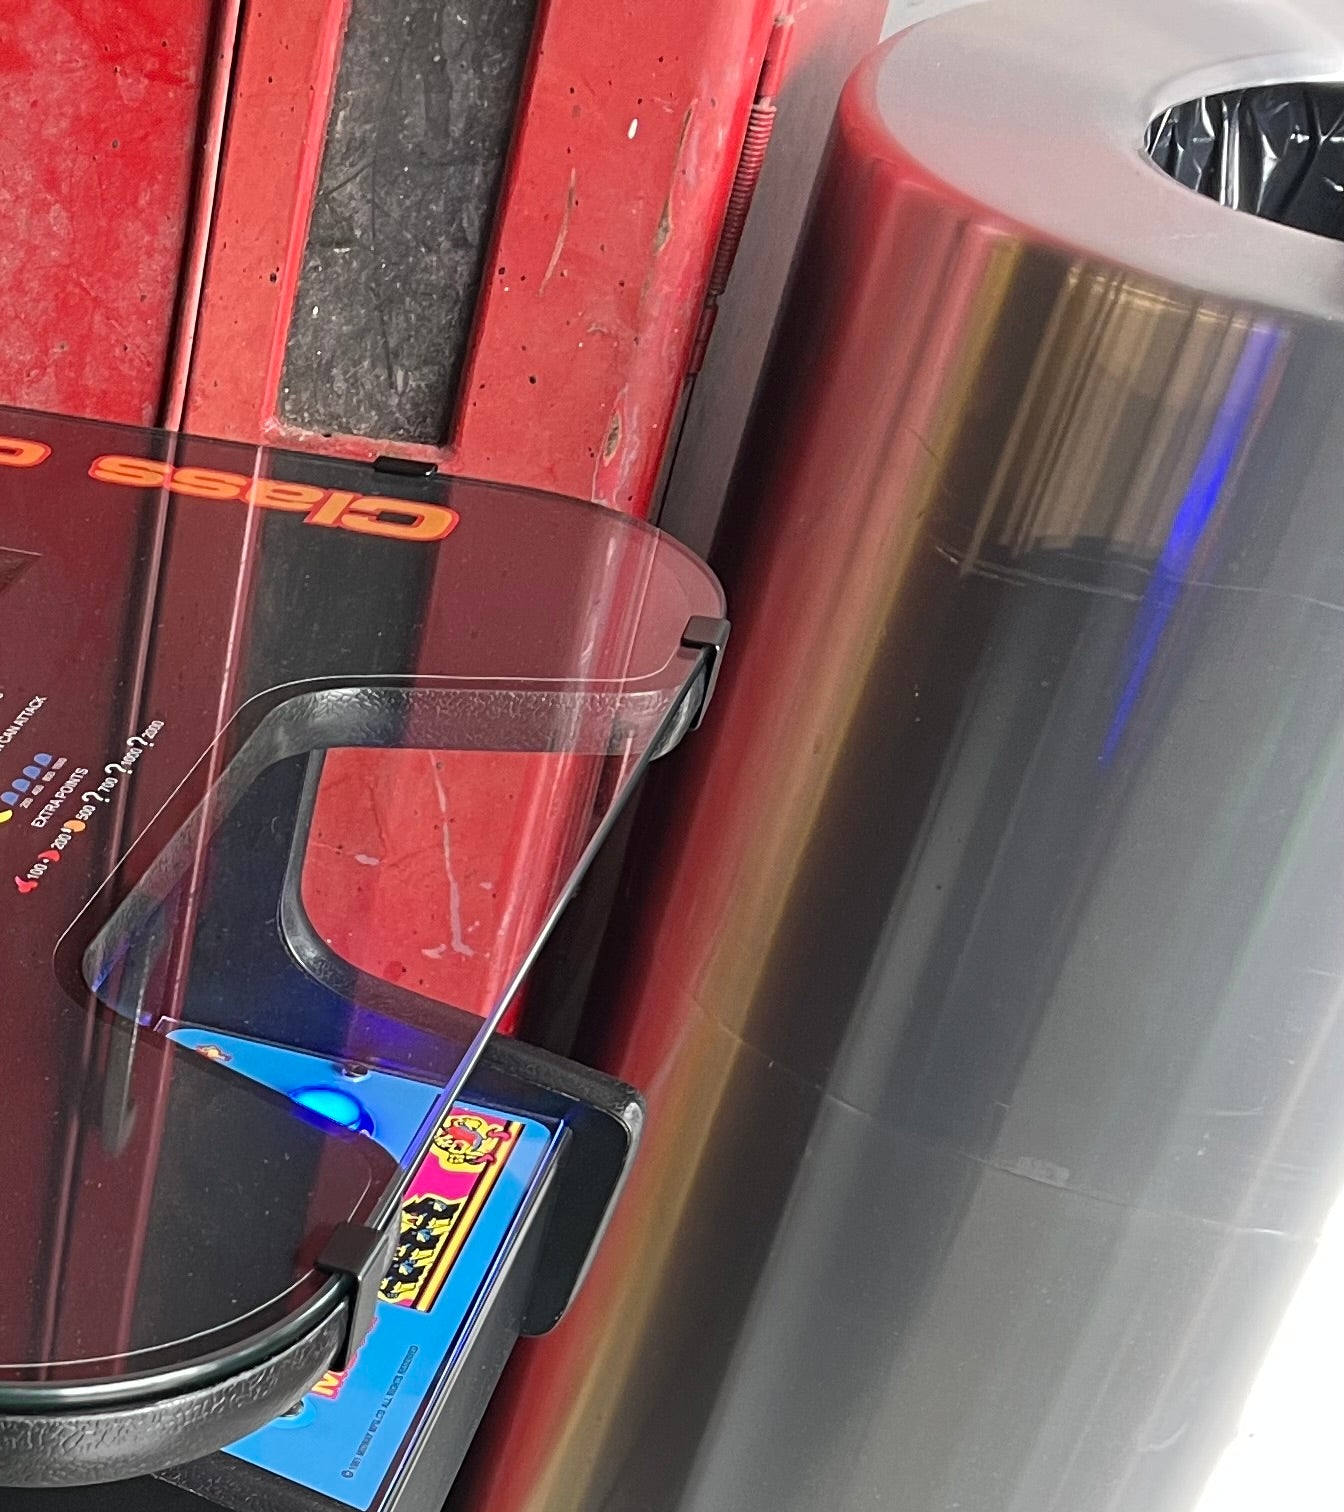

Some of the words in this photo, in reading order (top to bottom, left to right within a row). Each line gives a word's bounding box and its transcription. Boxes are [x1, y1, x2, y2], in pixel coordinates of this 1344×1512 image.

[88, 455, 460, 541] Class
[13, 695, 47, 727] ATTACK
[31, 799, 60, 828] EXTRA
[55, 767, 89, 800] POINTS
[75, 804, 96, 821] 500
